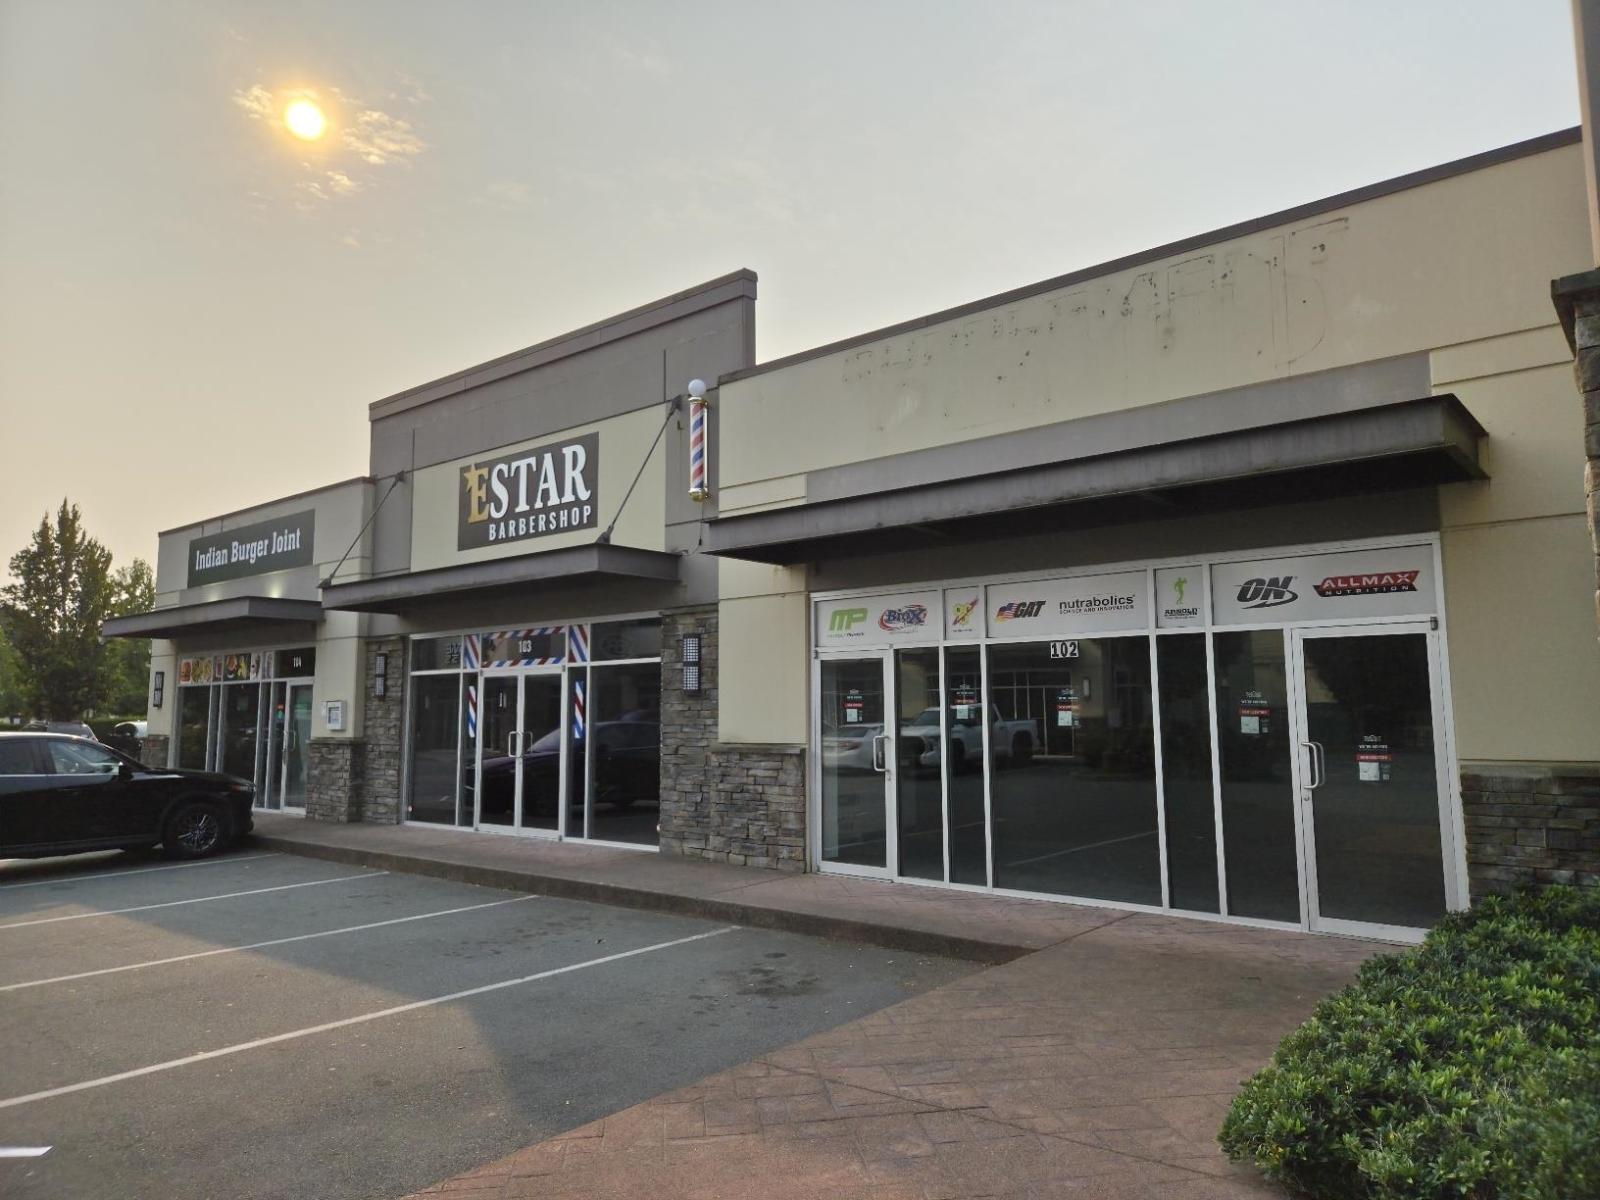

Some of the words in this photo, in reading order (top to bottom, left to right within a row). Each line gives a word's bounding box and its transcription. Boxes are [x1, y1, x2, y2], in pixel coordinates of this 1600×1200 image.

[464, 444, 591, 523] ESTAR
[489, 505, 591, 540] BARBERSHOP
[195, 547, 228, 571] Indian
[231, 539, 268, 564] Burger
[271, 528, 301, 554] Joint
[1322, 573, 1410, 589] ALLMAX
[1325, 585, 1409, 596] NUTRITION
[1014, 600, 1047, 618] GAT
[1059, 595, 1134, 609] nutrabolics
[518, 639, 532, 653] 103
[1051, 642, 1077, 658] 102
